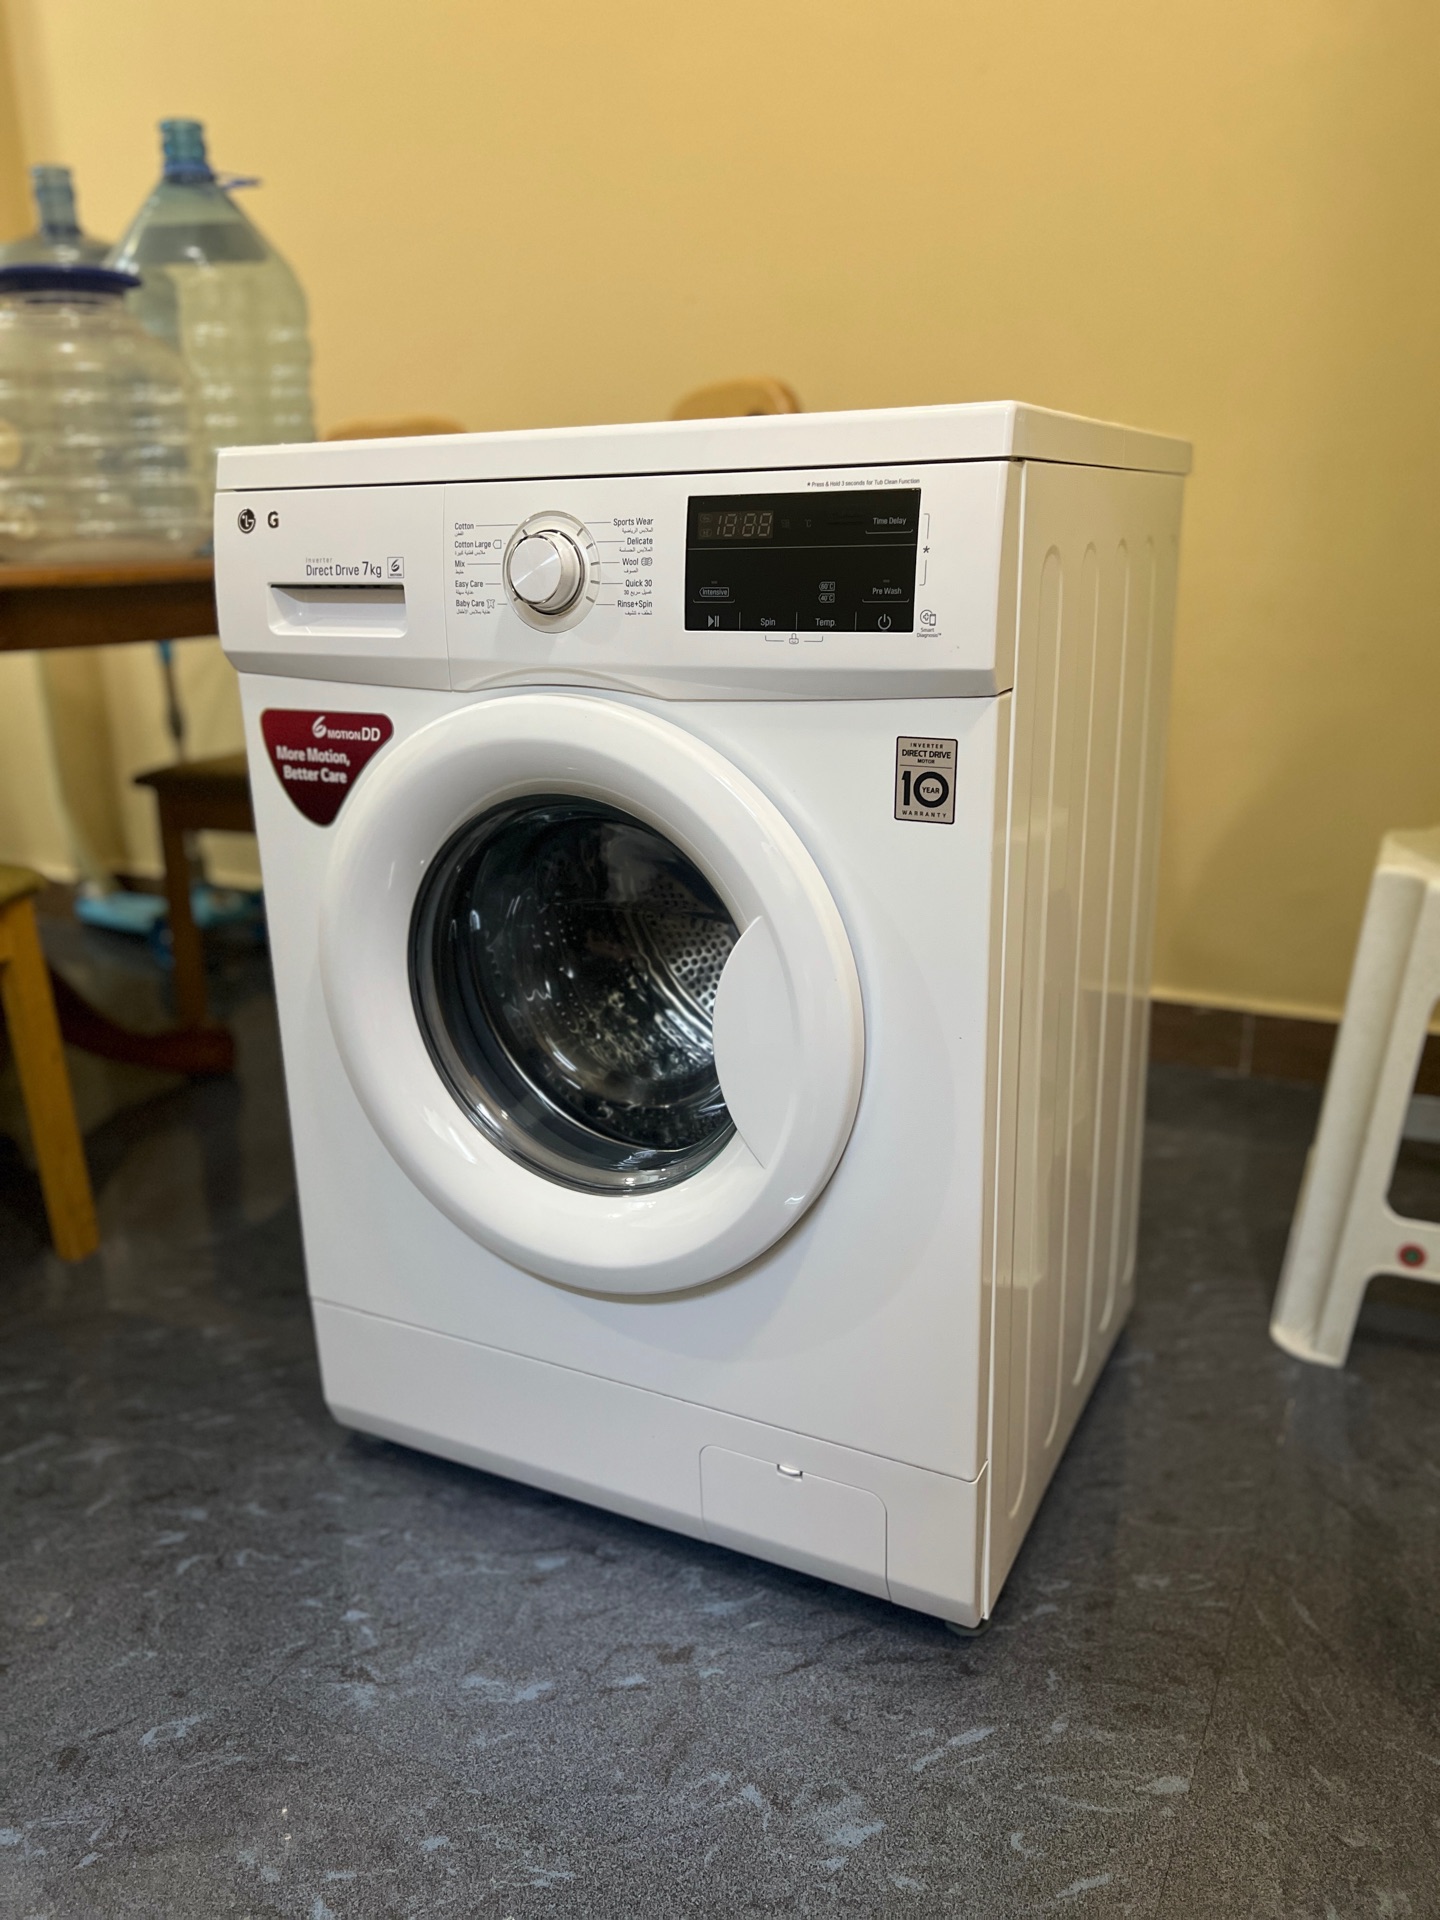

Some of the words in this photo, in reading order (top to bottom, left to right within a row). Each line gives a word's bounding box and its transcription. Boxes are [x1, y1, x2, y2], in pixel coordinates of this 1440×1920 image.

[613, 518, 634, 527] Sports
[636, 518, 654, 526] Wear
[872, 517, 888, 525] Time
[888, 516, 907, 525] Delay
[454, 522, 474, 530] Cotton
[475, 541, 491, 549] Large
[306, 564, 333, 576] Direct
[335, 564, 360, 576] Drive
[455, 580, 468, 589] Easy
[625, 579, 643, 587] Quick
[644, 579, 652, 587] 30
[702, 588, 727, 596] Intensive
[456, 600, 470, 608] Baby
[760, 618, 776, 628] Spin
[815, 618, 836, 627] Temp.
[276, 745, 305, 762] More
[306, 748, 351, 767] Motion,
[902, 749, 928, 757] DIRECT
[929, 751, 951, 759] DRIVE
[283, 765, 319, 782] Better
[320, 768, 347, 784] Care
[901, 771, 949, 808] 10
[902, 810, 947, 818] WARRANTY
